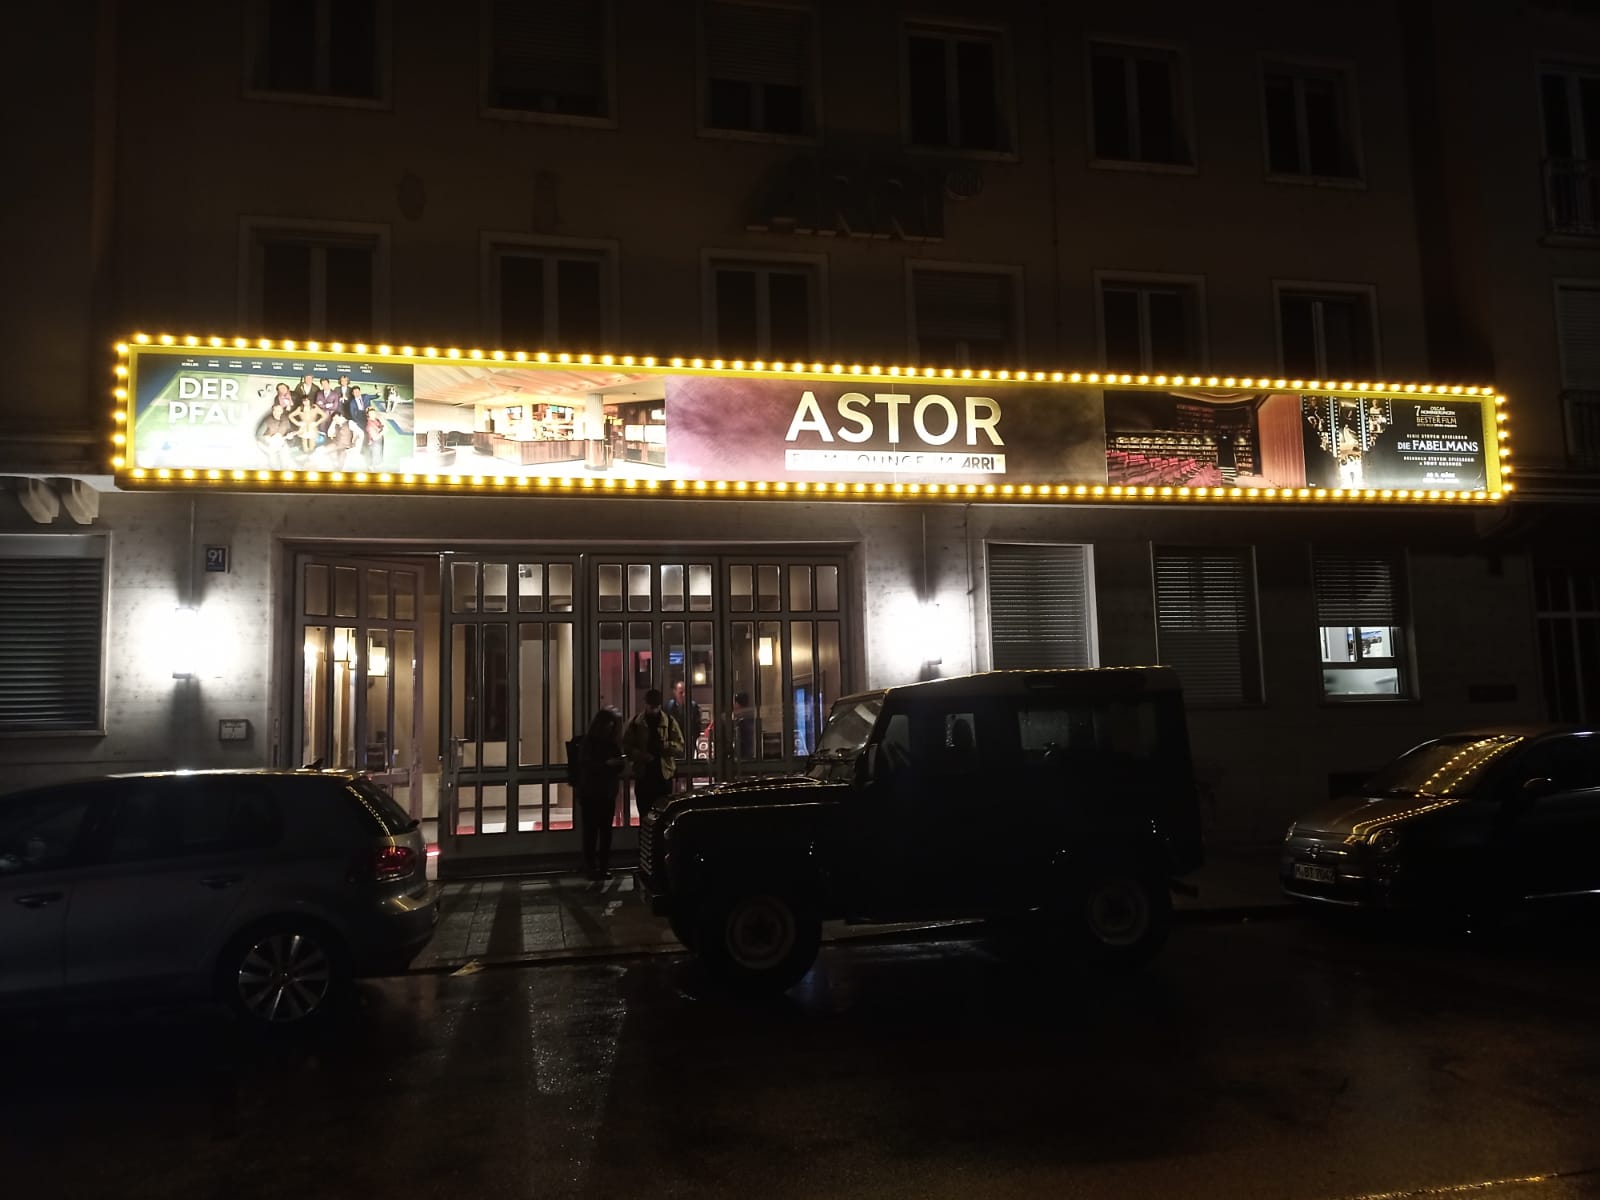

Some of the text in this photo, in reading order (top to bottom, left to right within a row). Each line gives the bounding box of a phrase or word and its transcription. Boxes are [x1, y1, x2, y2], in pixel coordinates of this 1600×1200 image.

[178, 376, 240, 401] DER
[167, 401, 249, 425] PFAU
[1414, 405, 1421, 416] 7
[785, 391, 1005, 446] ASTOR
[1416, 416, 1457, 425] BESTER FILM
[1397, 440, 1478, 452] DIE FABELMANS
[961, 456, 995, 471] ARRI
[207, 549, 223, 563] 91
